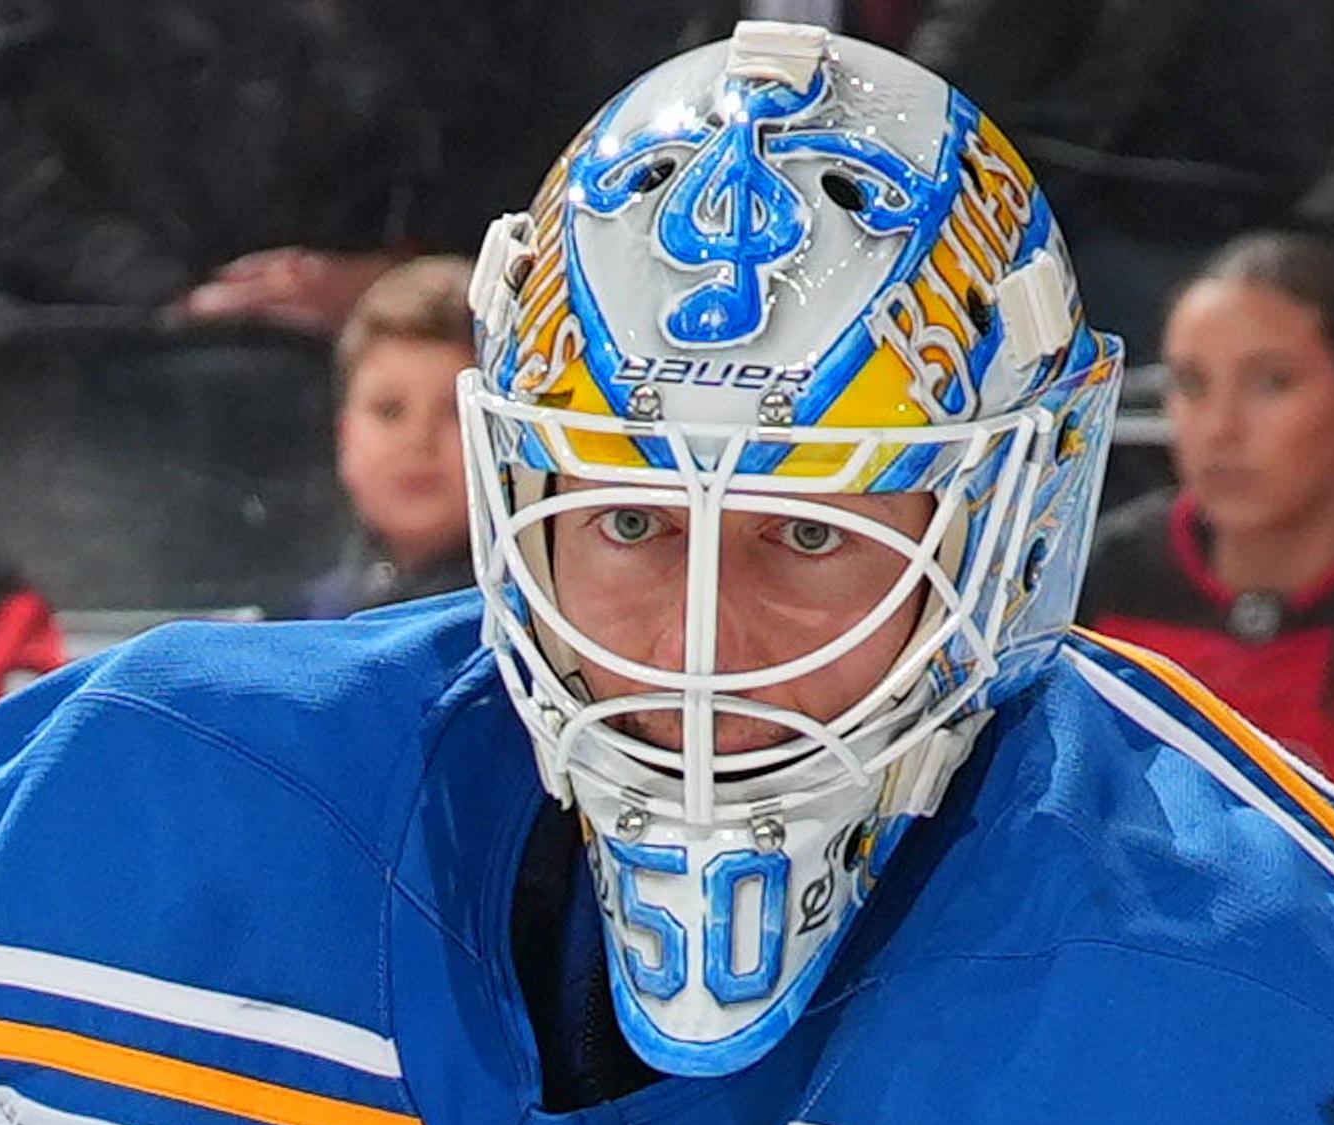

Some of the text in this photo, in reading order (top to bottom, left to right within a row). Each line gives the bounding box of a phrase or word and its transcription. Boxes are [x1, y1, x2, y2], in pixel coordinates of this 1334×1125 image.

[863, 130, 1033, 426] BLUES
[614, 356, 814, 393] BAUER
[604, 836, 791, 1005] 50
